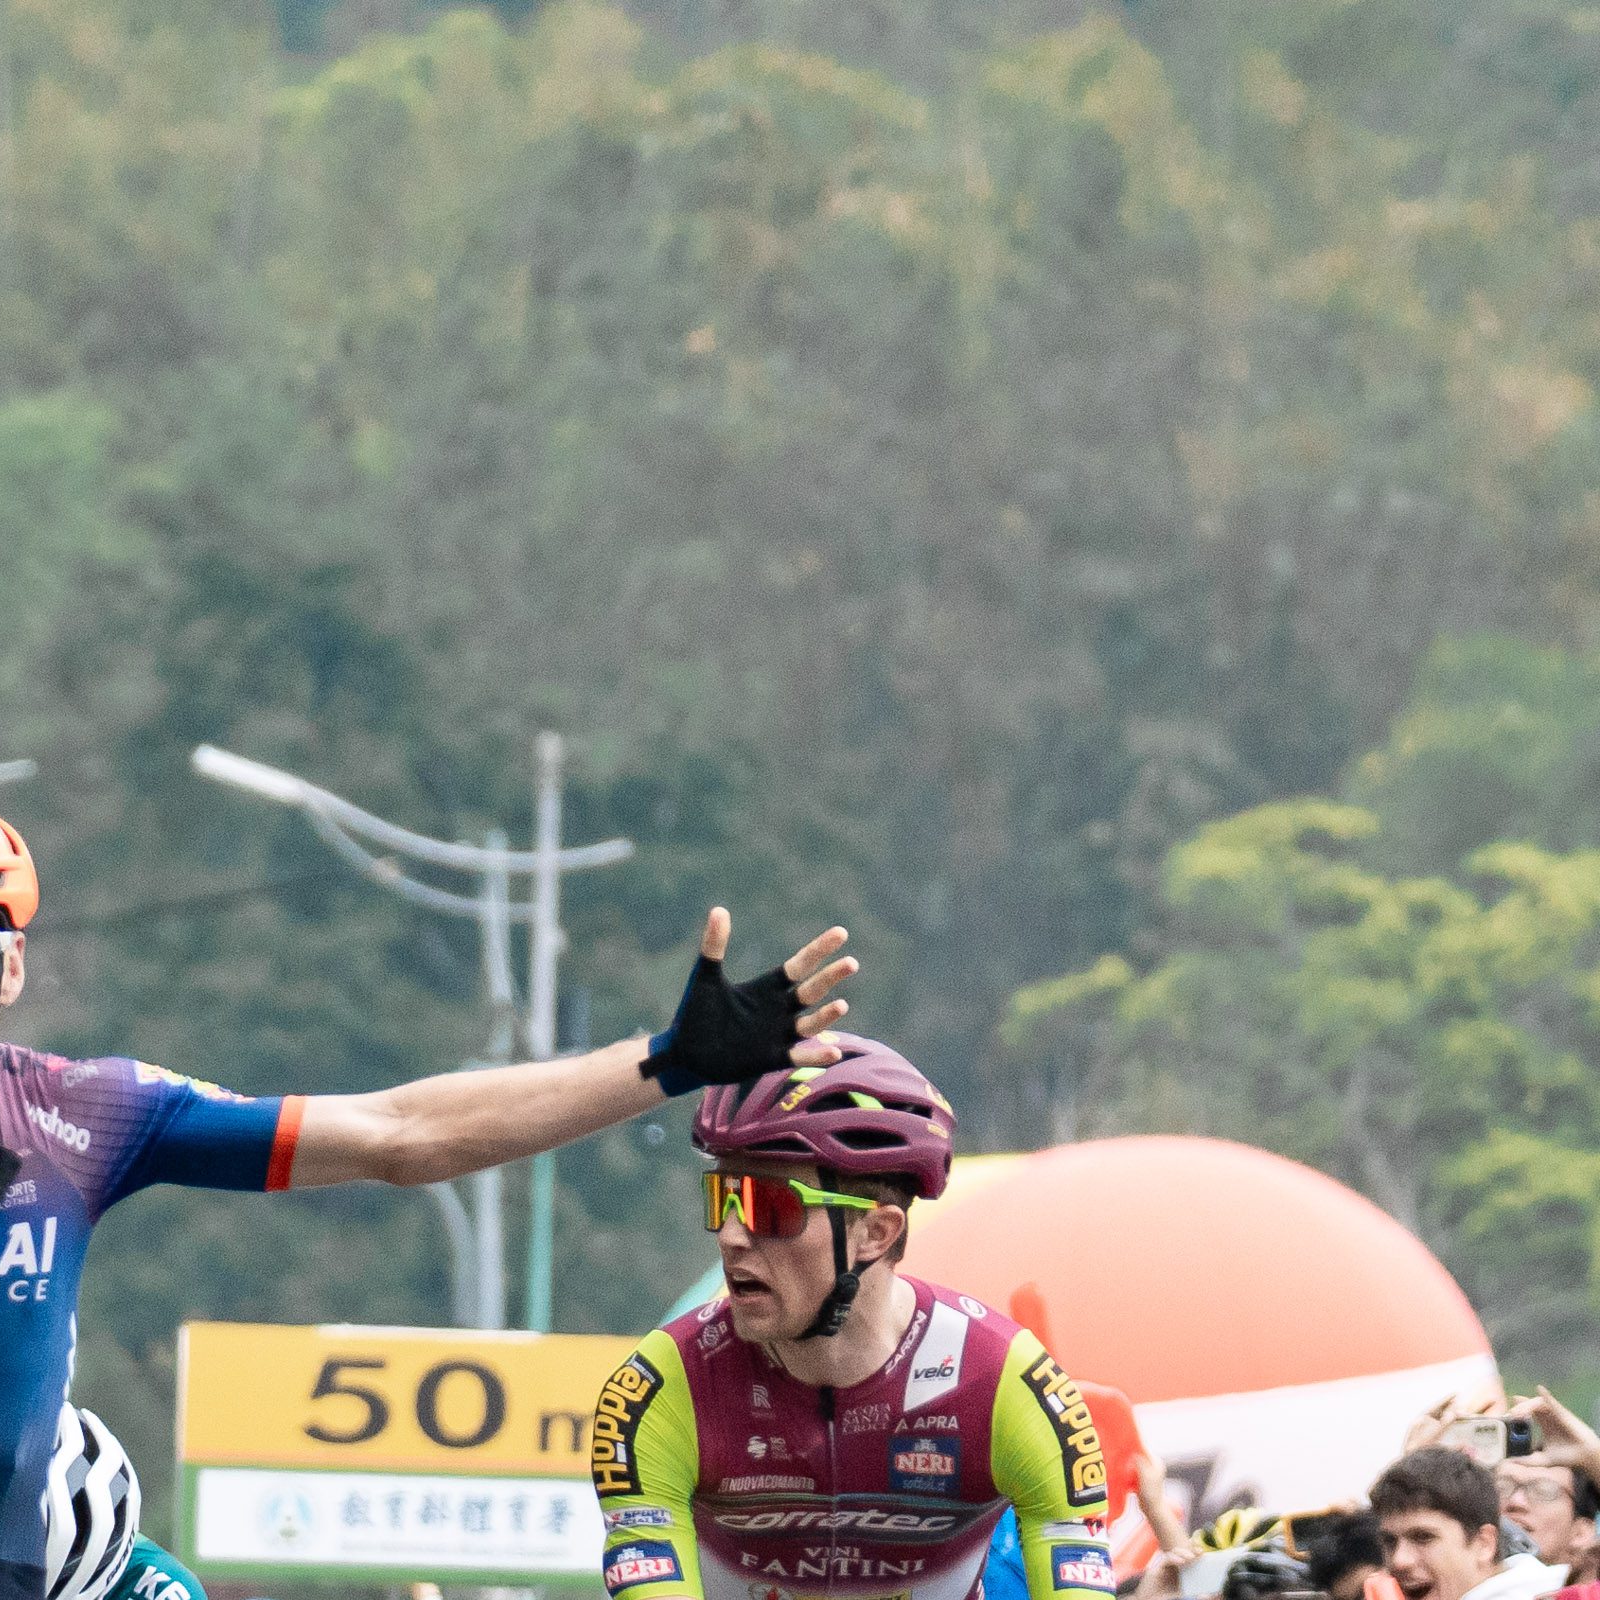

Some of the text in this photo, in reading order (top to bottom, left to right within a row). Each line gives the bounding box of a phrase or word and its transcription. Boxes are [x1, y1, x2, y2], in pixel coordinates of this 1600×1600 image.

[4, 1180, 36, 1198] ORTS
[304, 1357, 506, 1450] 50
[898, 1453, 953, 1474] NERI
[605, 1557, 674, 1586] NERI
[740, 1551, 925, 1577] FANTINI
[1061, 1562, 1115, 1585] NER
